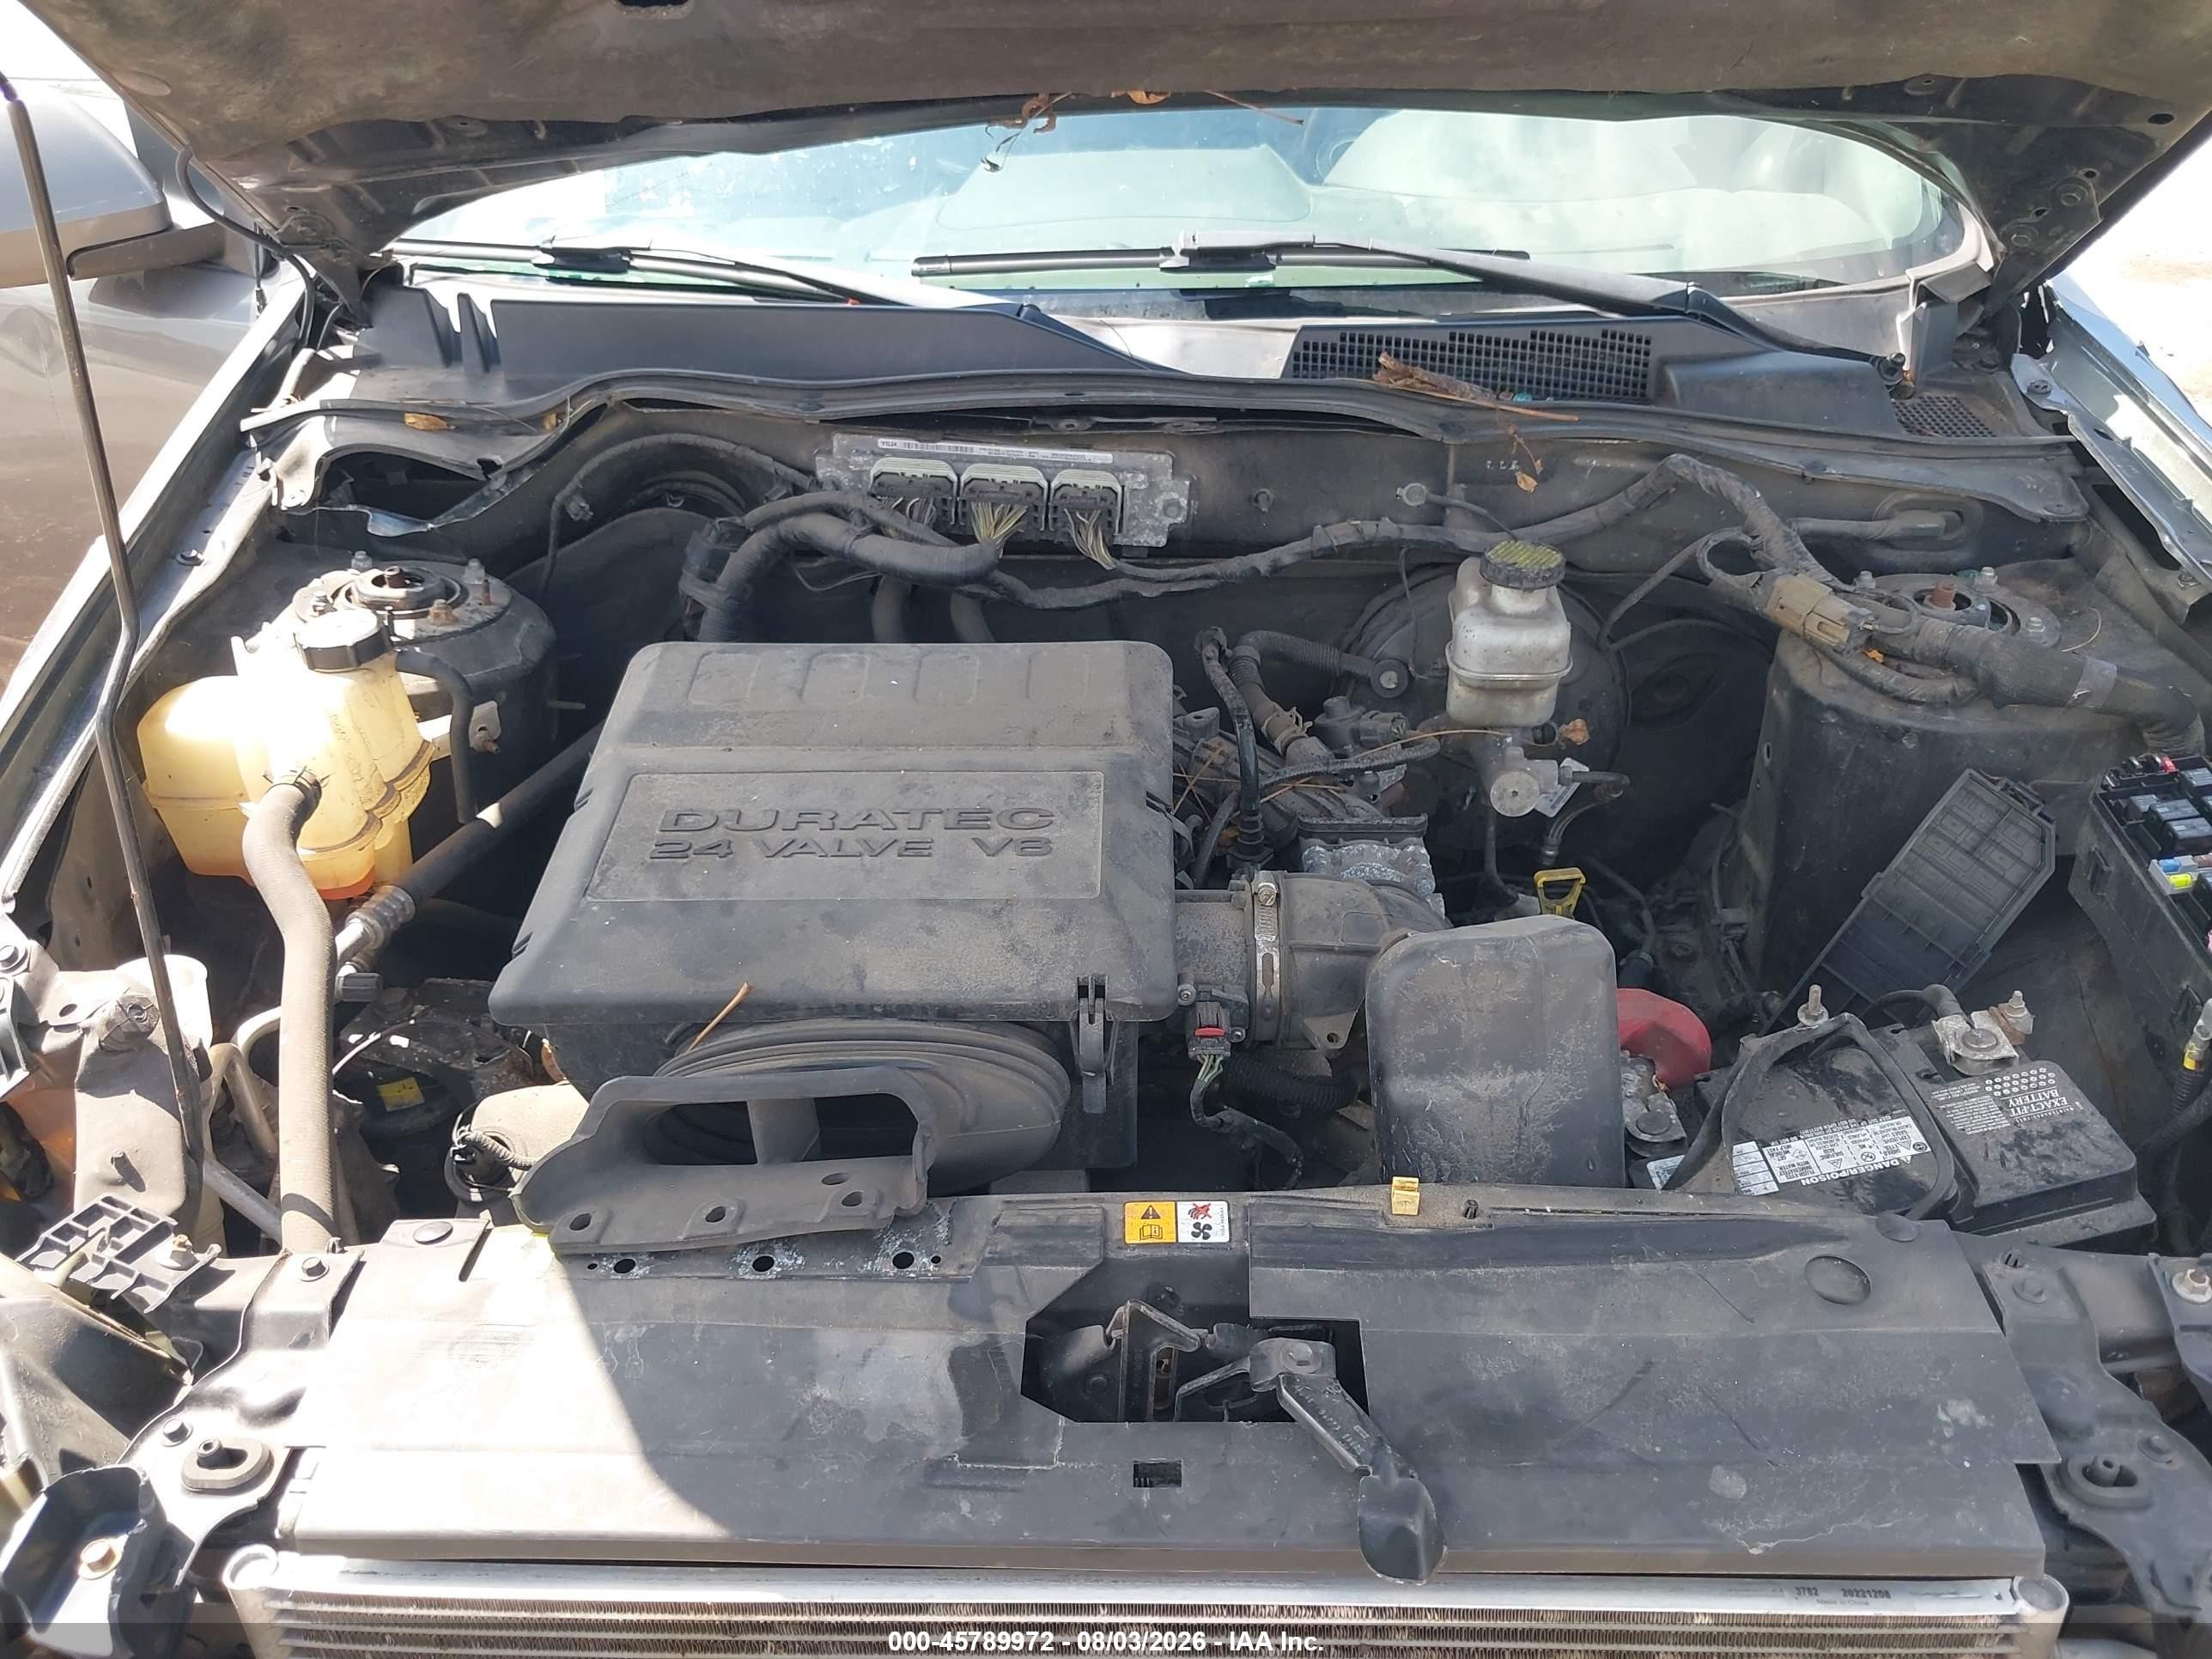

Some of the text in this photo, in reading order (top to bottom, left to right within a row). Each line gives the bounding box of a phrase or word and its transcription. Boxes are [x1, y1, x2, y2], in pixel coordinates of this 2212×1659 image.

[658, 808, 1054, 832] DURATEC
[649, 836, 1054, 860] 24 VALVE V6
[2009, 1089, 2059, 1107] BATTERY
[2010, 1097, 2068, 1116] EXACT-FIT
[1801, 1158, 1899, 1185] DANGER/POISON
